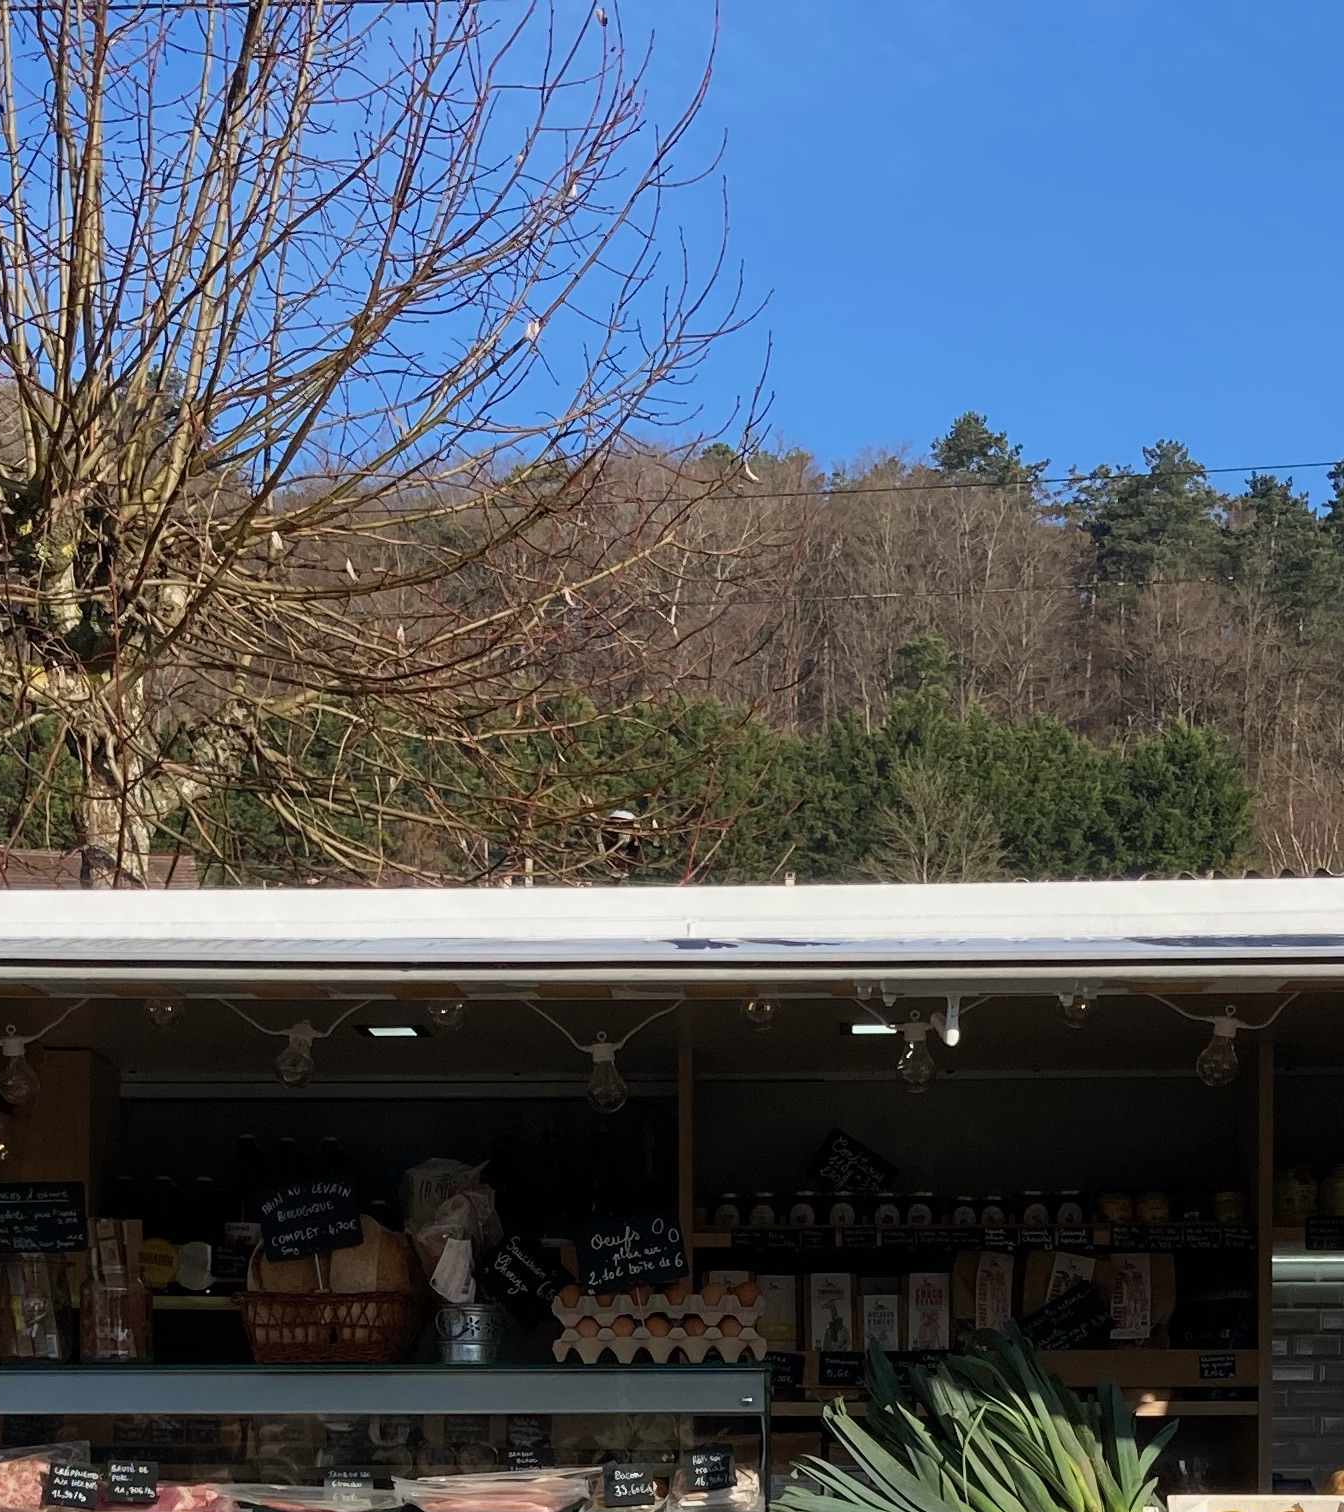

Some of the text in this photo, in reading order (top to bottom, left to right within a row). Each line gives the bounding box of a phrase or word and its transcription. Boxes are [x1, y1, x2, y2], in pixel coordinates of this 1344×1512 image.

[261, 1192, 284, 1216] PAIN
[287, 1186, 302, 1197] AU
[277, 1200, 335, 1223] BIOLOGIQUE
[271, 1227, 319, 1247] COMPLET
[674, 1251, 684, 1268] 6
[613, 1470, 644, 1480] Bacon
